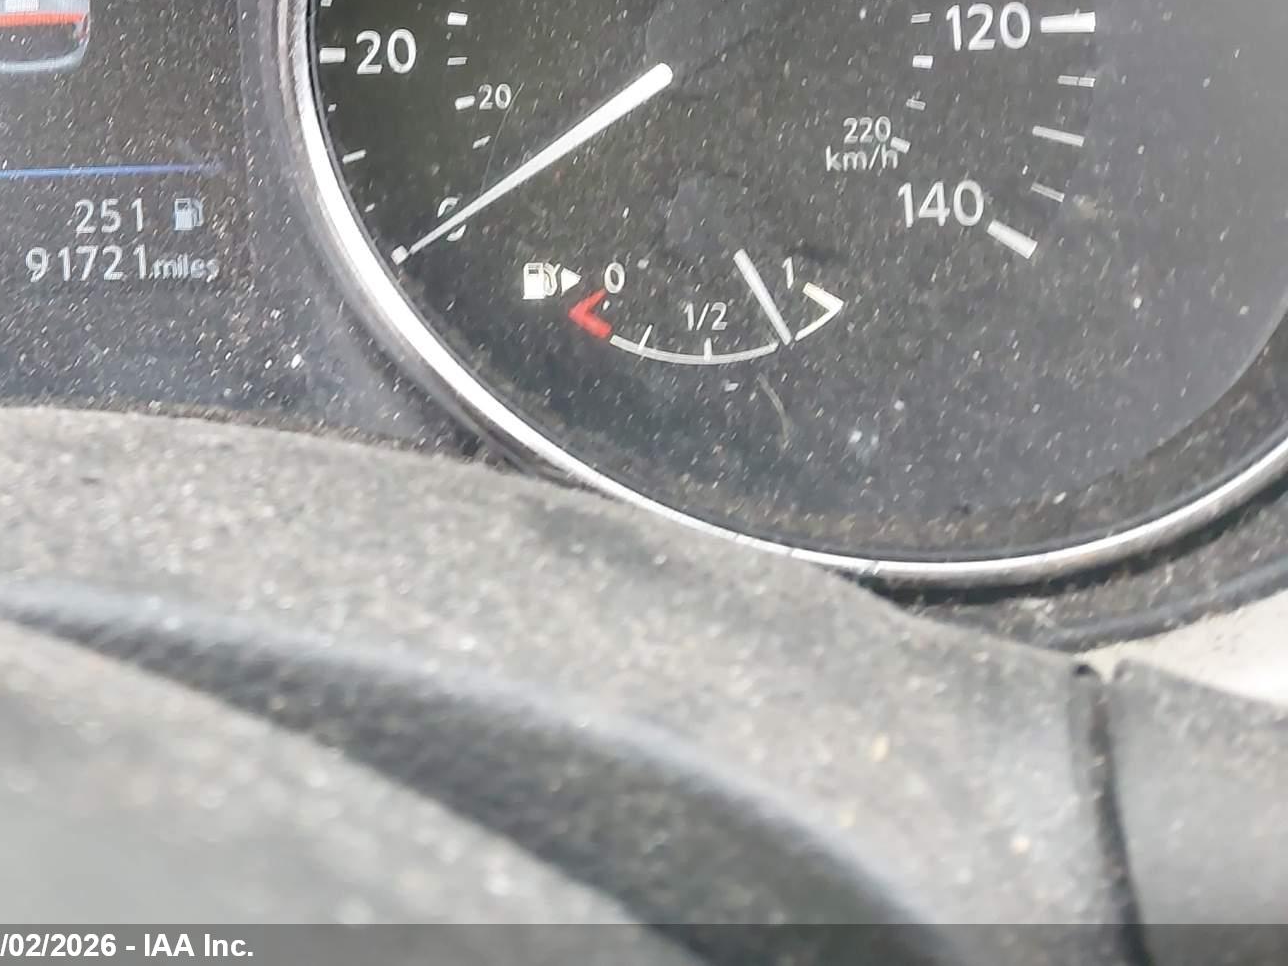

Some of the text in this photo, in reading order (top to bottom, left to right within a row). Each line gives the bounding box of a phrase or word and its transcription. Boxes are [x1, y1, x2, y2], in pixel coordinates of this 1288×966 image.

[945, 2, 1031, 50] 120
[356, 29, 416, 74] 20
[478, 84, 512, 109] 20
[843, 117, 891, 145] 220
[825, 146, 898, 171] km/h
[73, 198, 144, 233] 251
[898, 180, 984, 227] 140
[603, 262, 626, 295] 0
[781, 257, 795, 289] 1
[684, 302, 728, 331] 1/2
